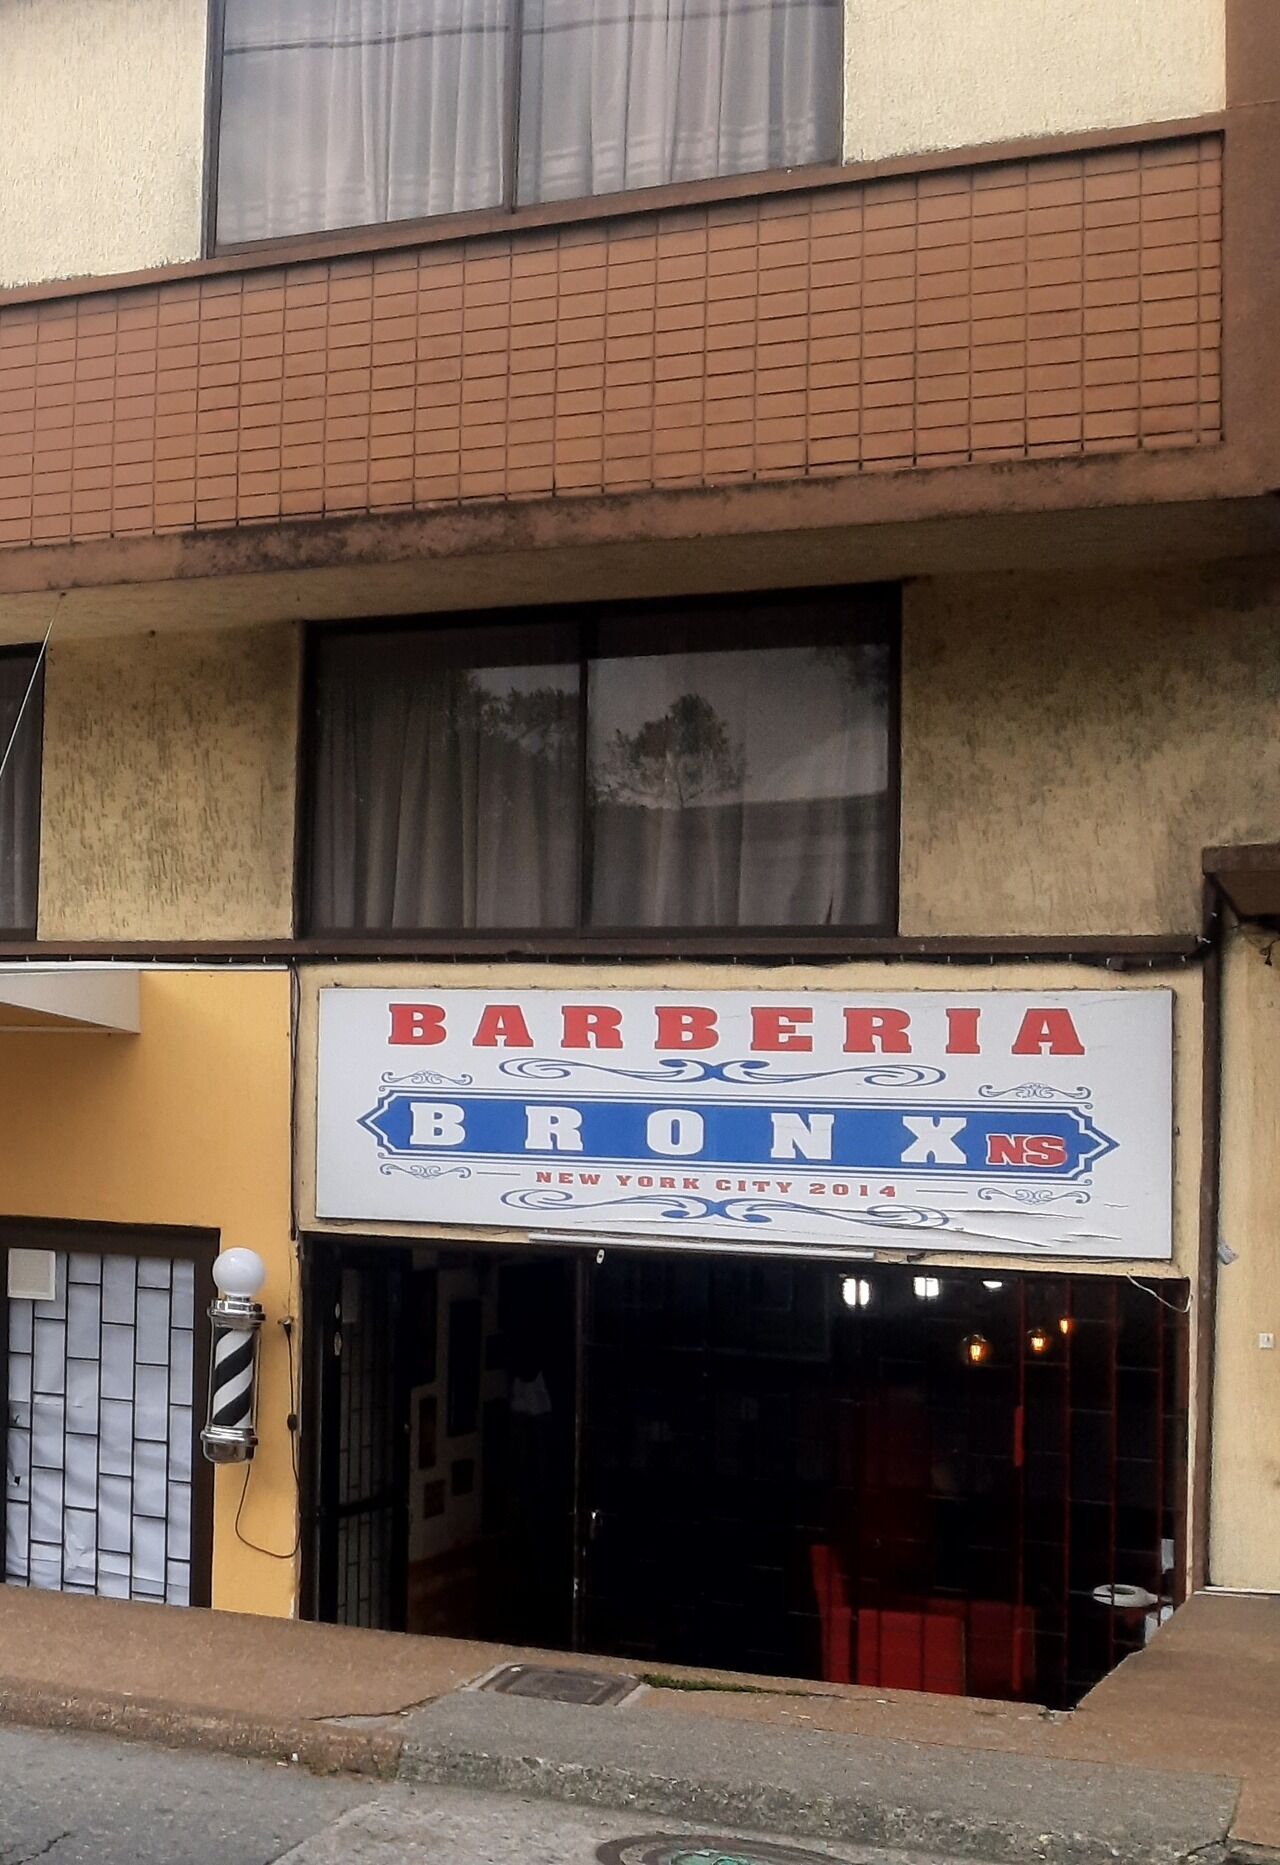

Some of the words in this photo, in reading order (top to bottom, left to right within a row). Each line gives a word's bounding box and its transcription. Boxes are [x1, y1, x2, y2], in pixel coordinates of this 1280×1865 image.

[388, 1003, 1086, 1056] BARBERIA
[409, 1102, 967, 1165] BRONX
[986, 1134, 1068, 1168] NS
[535, 1171, 601, 1186] NEW
[616, 1174, 699, 1191] YORK
[715, 1178, 794, 1194] CITY
[808, 1182, 896, 1199] 2014
